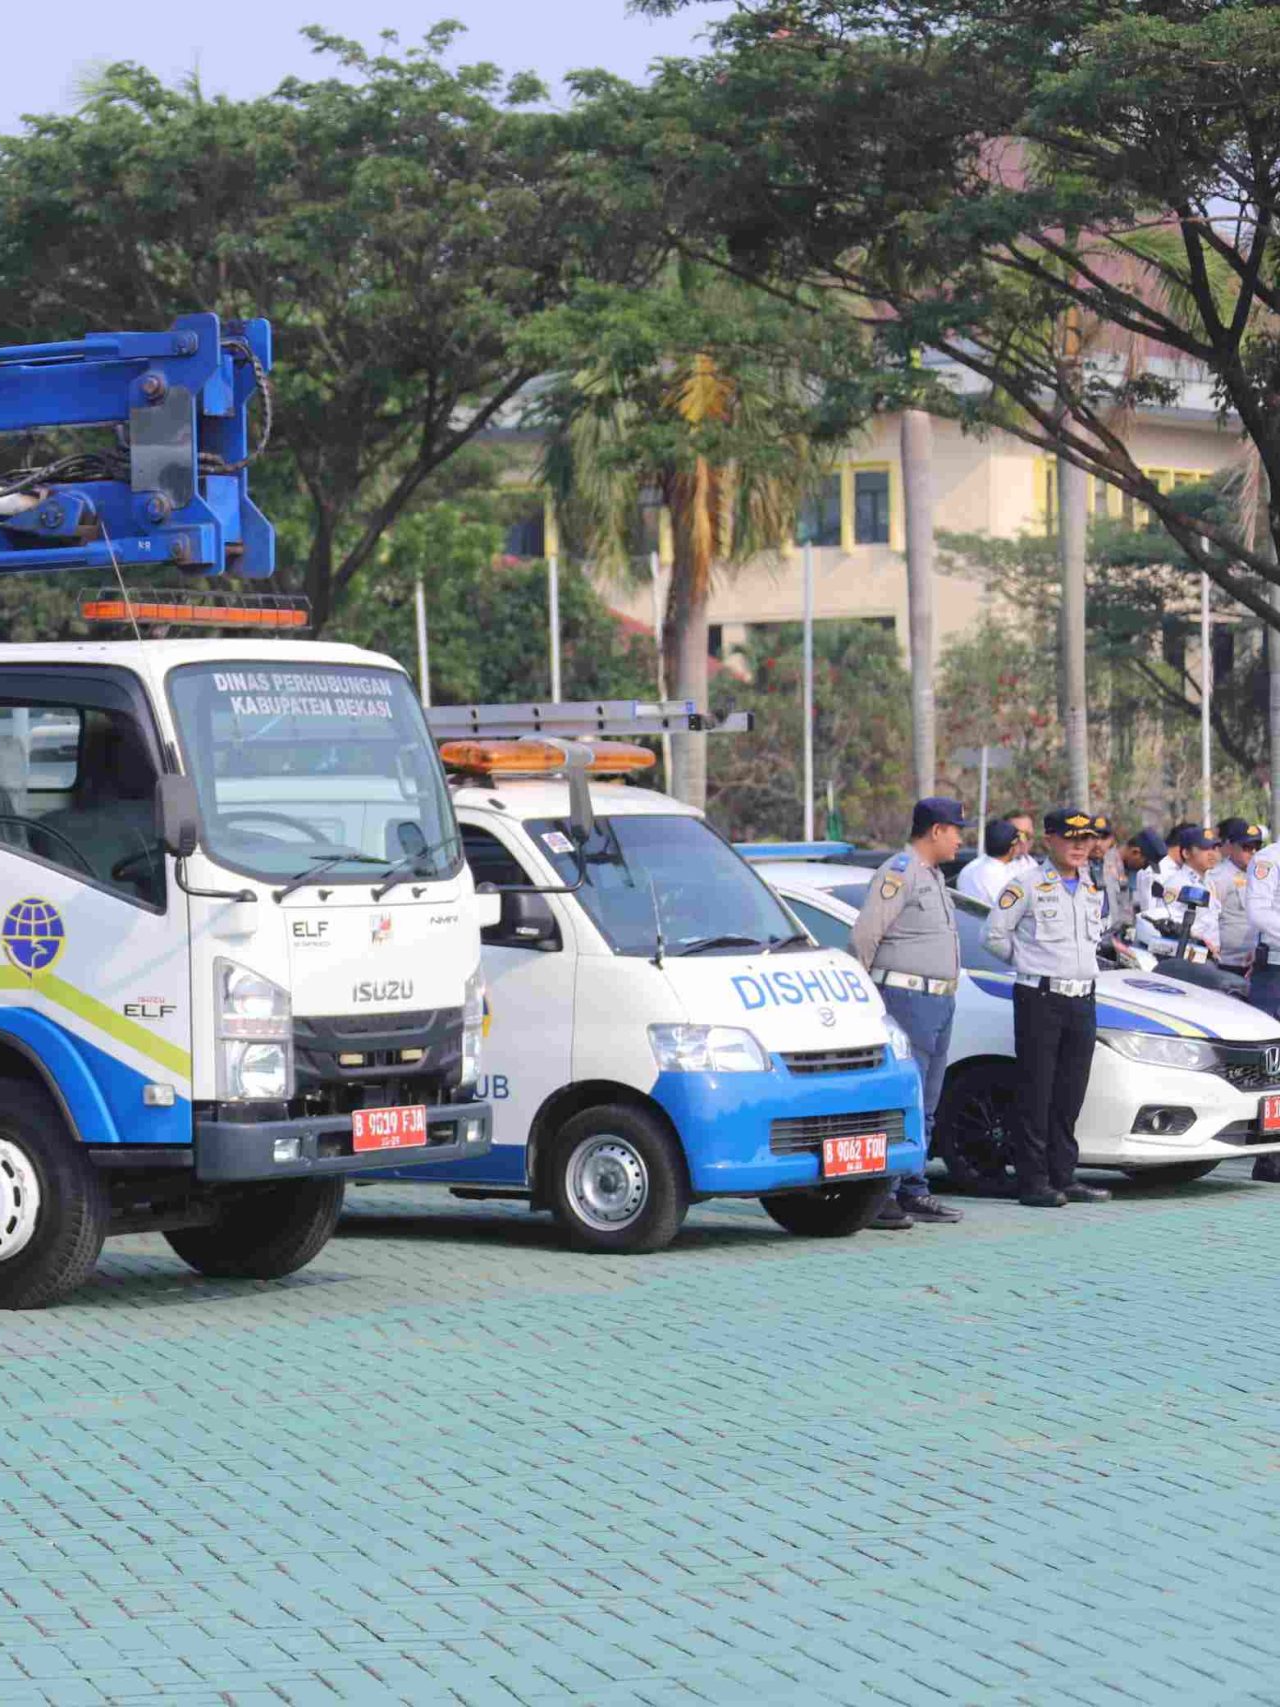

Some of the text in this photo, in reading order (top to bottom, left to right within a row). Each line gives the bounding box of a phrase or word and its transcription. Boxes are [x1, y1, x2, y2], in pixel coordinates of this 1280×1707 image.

[213, 673, 392, 697] DINAS PERHUBUNGAN
[230, 697, 393, 718] KABUPATEN BEKASI
[293, 921, 329, 938] ELF
[353, 980, 414, 1002] ISUZU
[731, 969, 870, 1010] DISHUB
[123, 1003, 177, 1018] ELF
[355, 1114, 363, 1137] B
[402, 1109, 423, 1133] FJA
[826, 1143, 834, 1163] B
[837, 1140, 862, 1161] 9062
